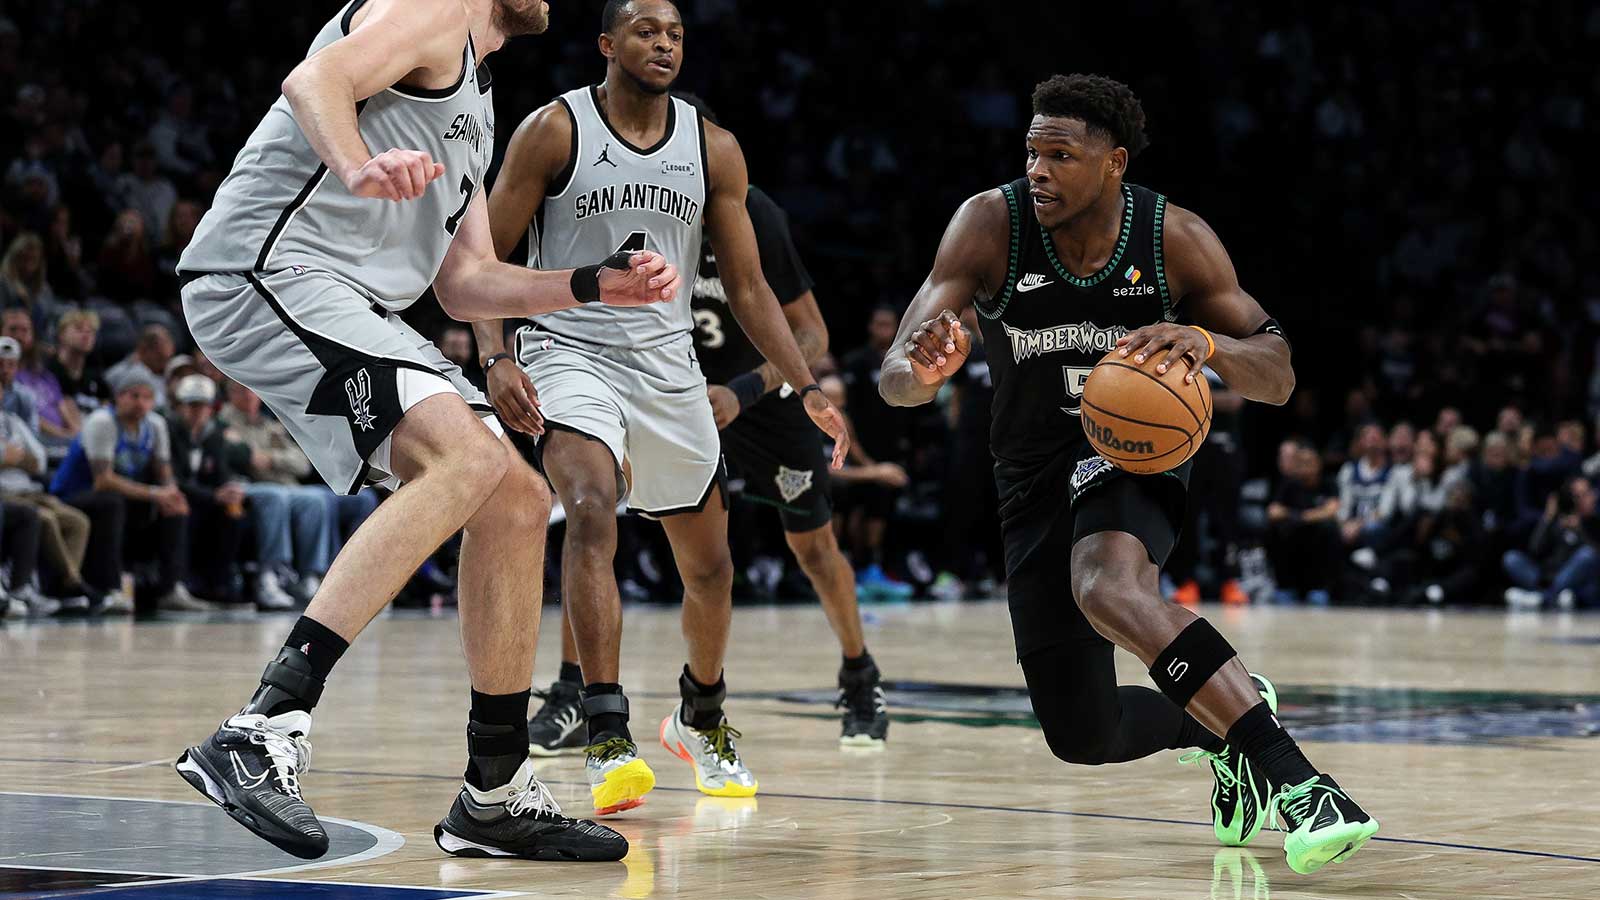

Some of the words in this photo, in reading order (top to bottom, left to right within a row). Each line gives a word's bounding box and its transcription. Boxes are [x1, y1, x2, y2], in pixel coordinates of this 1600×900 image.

[665, 164, 691, 172] LEDGER
[575, 185, 616, 220] SAN
[619, 183, 699, 227] ANTONIO
[1021, 273, 1047, 286] NIKE
[1113, 284, 1155, 297] sezzle
[1083, 410, 1156, 454] Wilson
[1166, 657, 1189, 682] 5
